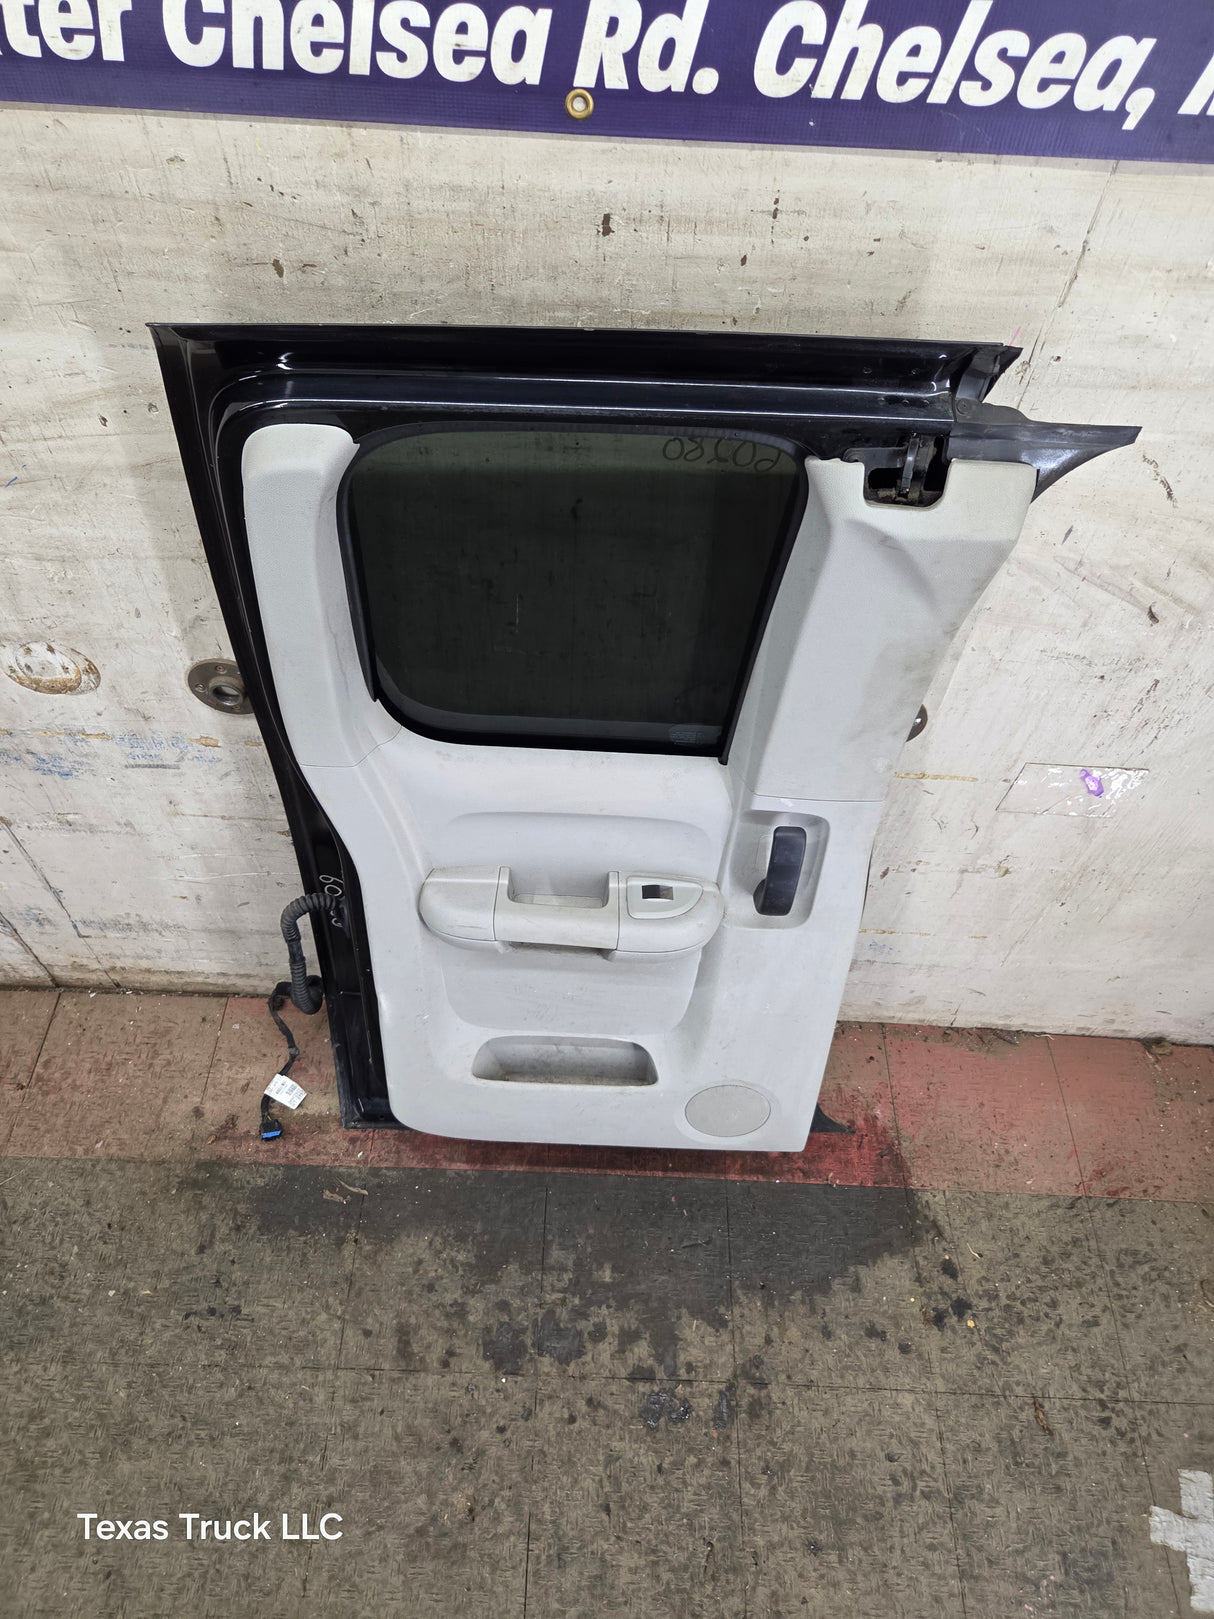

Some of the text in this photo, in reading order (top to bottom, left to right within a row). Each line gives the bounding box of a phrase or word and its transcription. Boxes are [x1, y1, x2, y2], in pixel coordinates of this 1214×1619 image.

[0, 0, 132, 61] ter
[163, 0, 553, 86] Chelsea
[573, 0, 719, 94] Rd.
[754, 0, 1157, 130] Chelsea,
